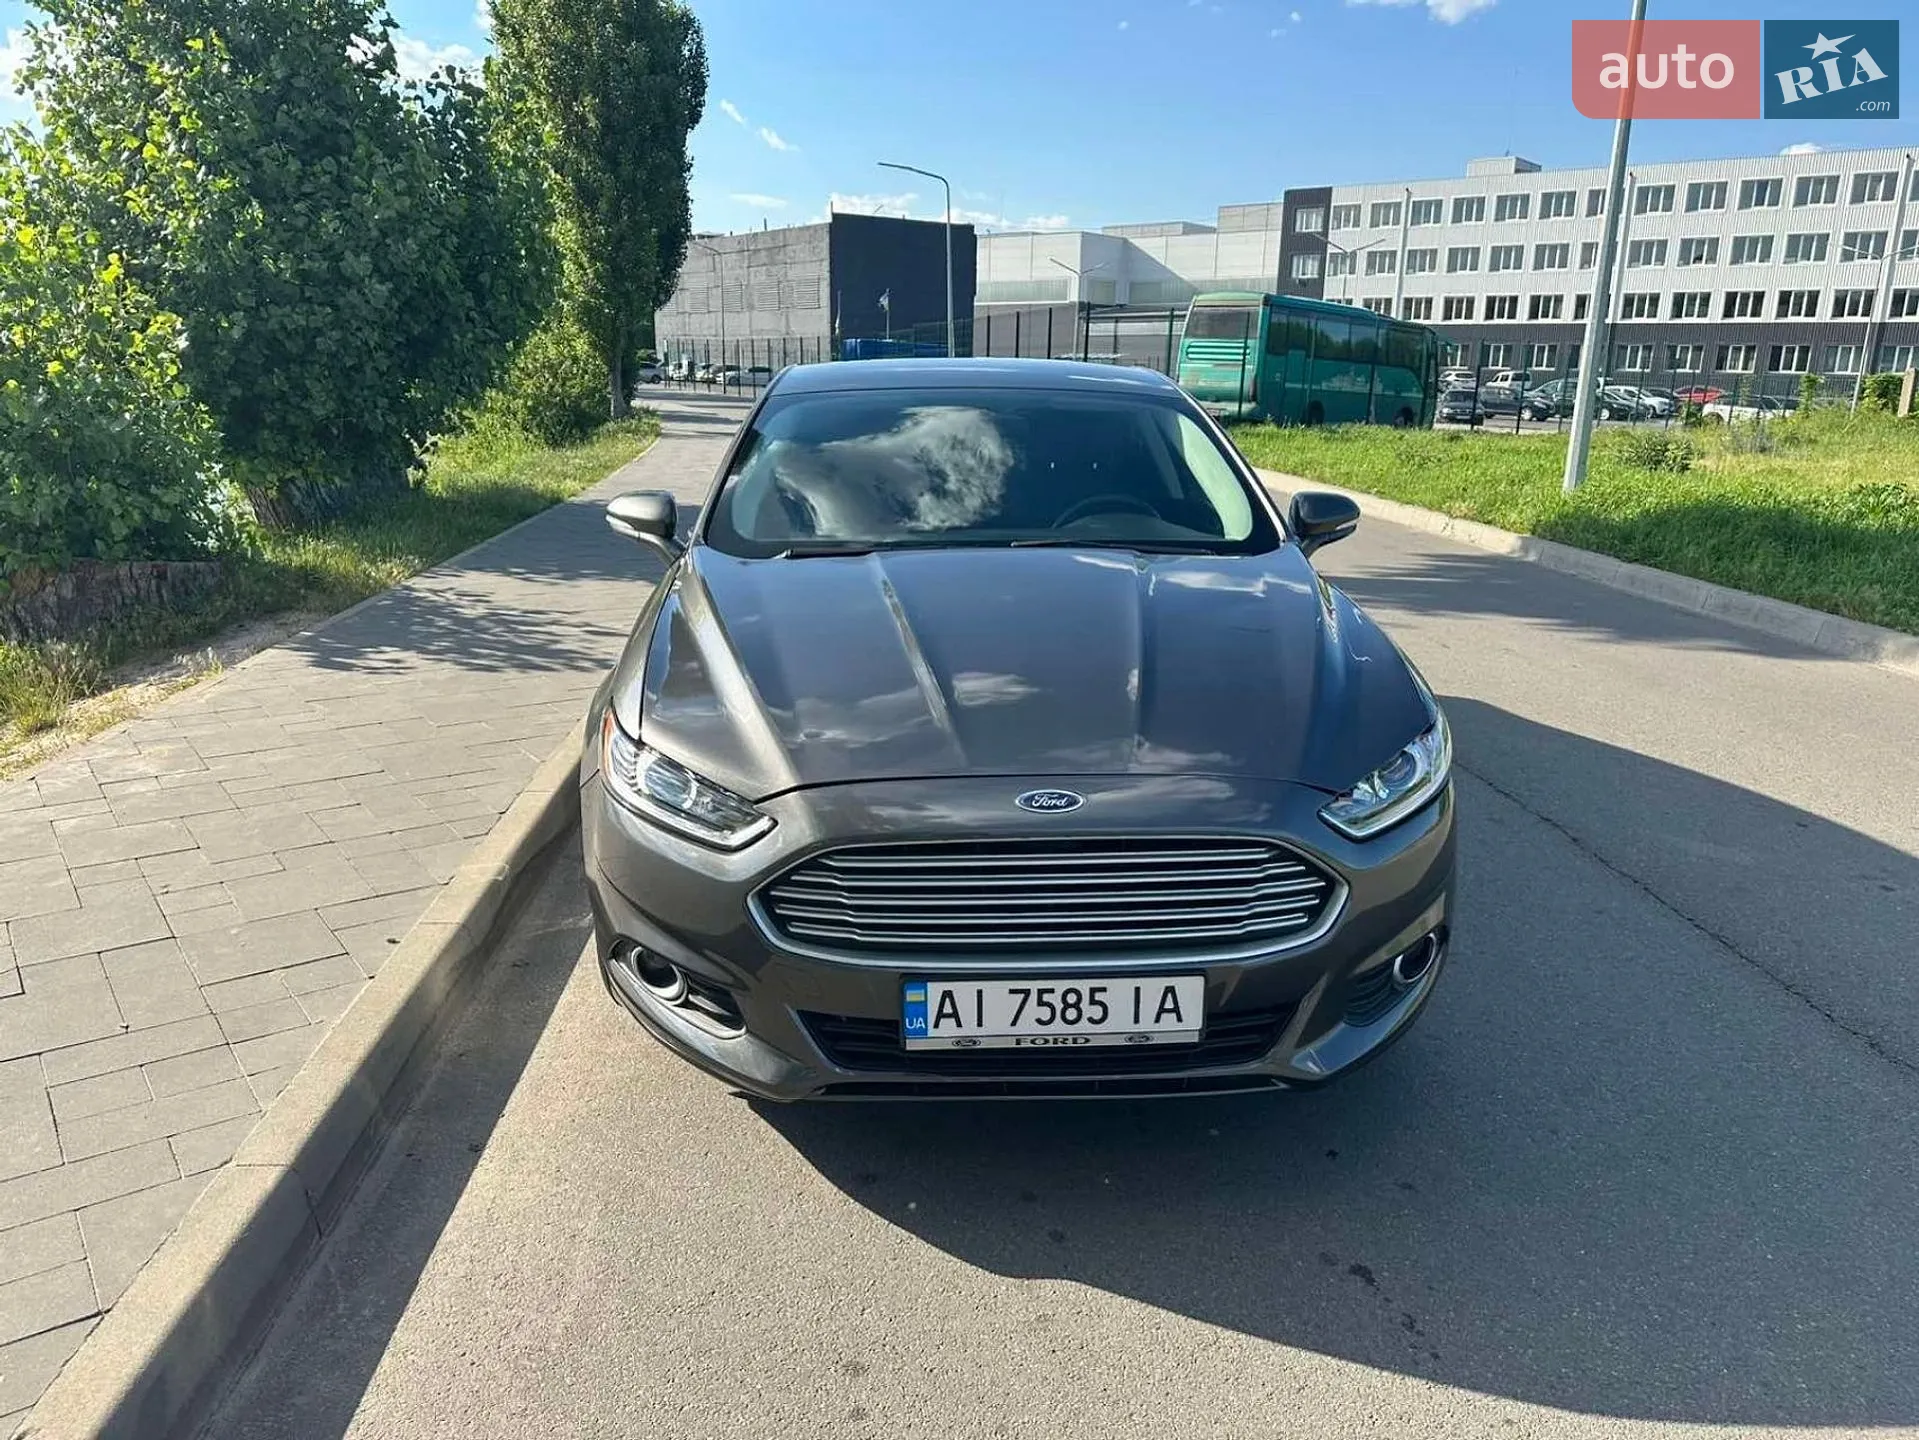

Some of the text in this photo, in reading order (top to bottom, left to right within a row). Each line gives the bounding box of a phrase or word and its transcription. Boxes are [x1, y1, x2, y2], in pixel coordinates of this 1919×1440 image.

[1031, 793, 1069, 807] Ford
[932, 985, 1184, 1029] AI 7585 IA
[905, 1017, 926, 1030] UA
[1014, 1036, 1091, 1047] FORD
